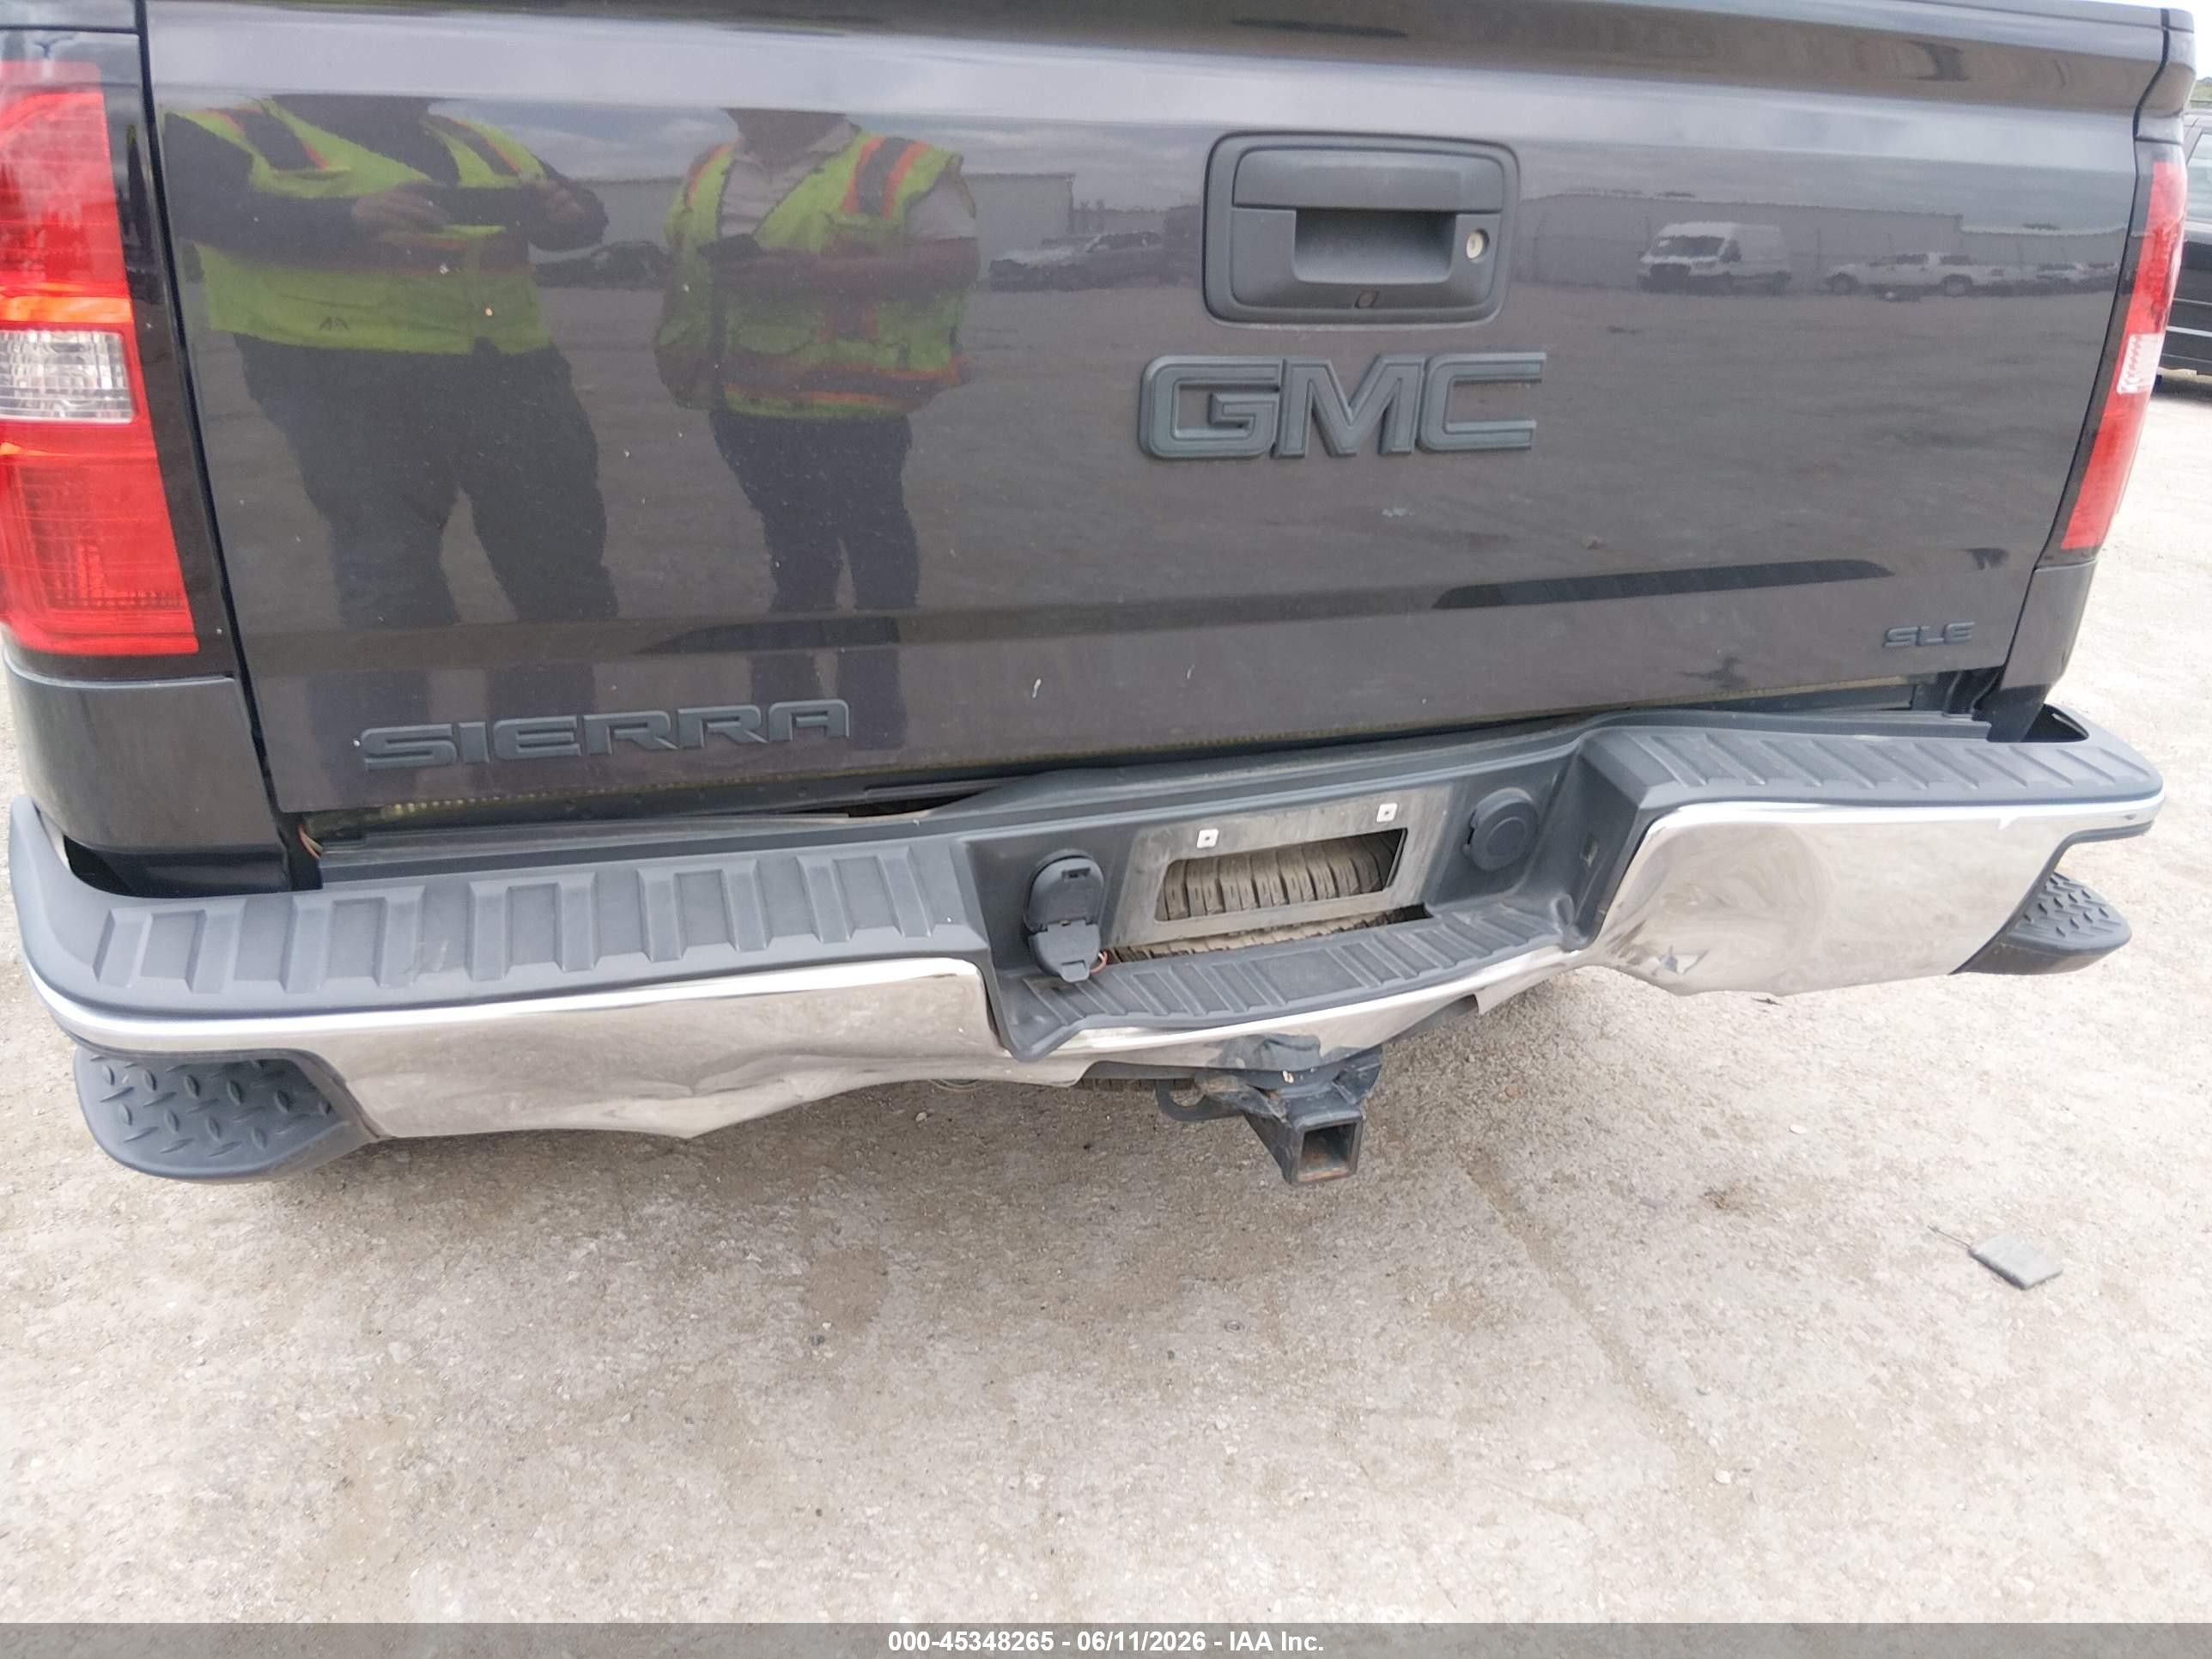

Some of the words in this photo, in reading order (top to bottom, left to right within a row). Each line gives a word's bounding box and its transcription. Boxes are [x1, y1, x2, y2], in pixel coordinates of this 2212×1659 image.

[1139, 351, 1547, 459] GMC
[1883, 621, 1975, 647] SLE
[360, 699, 850, 769] SIERRA
